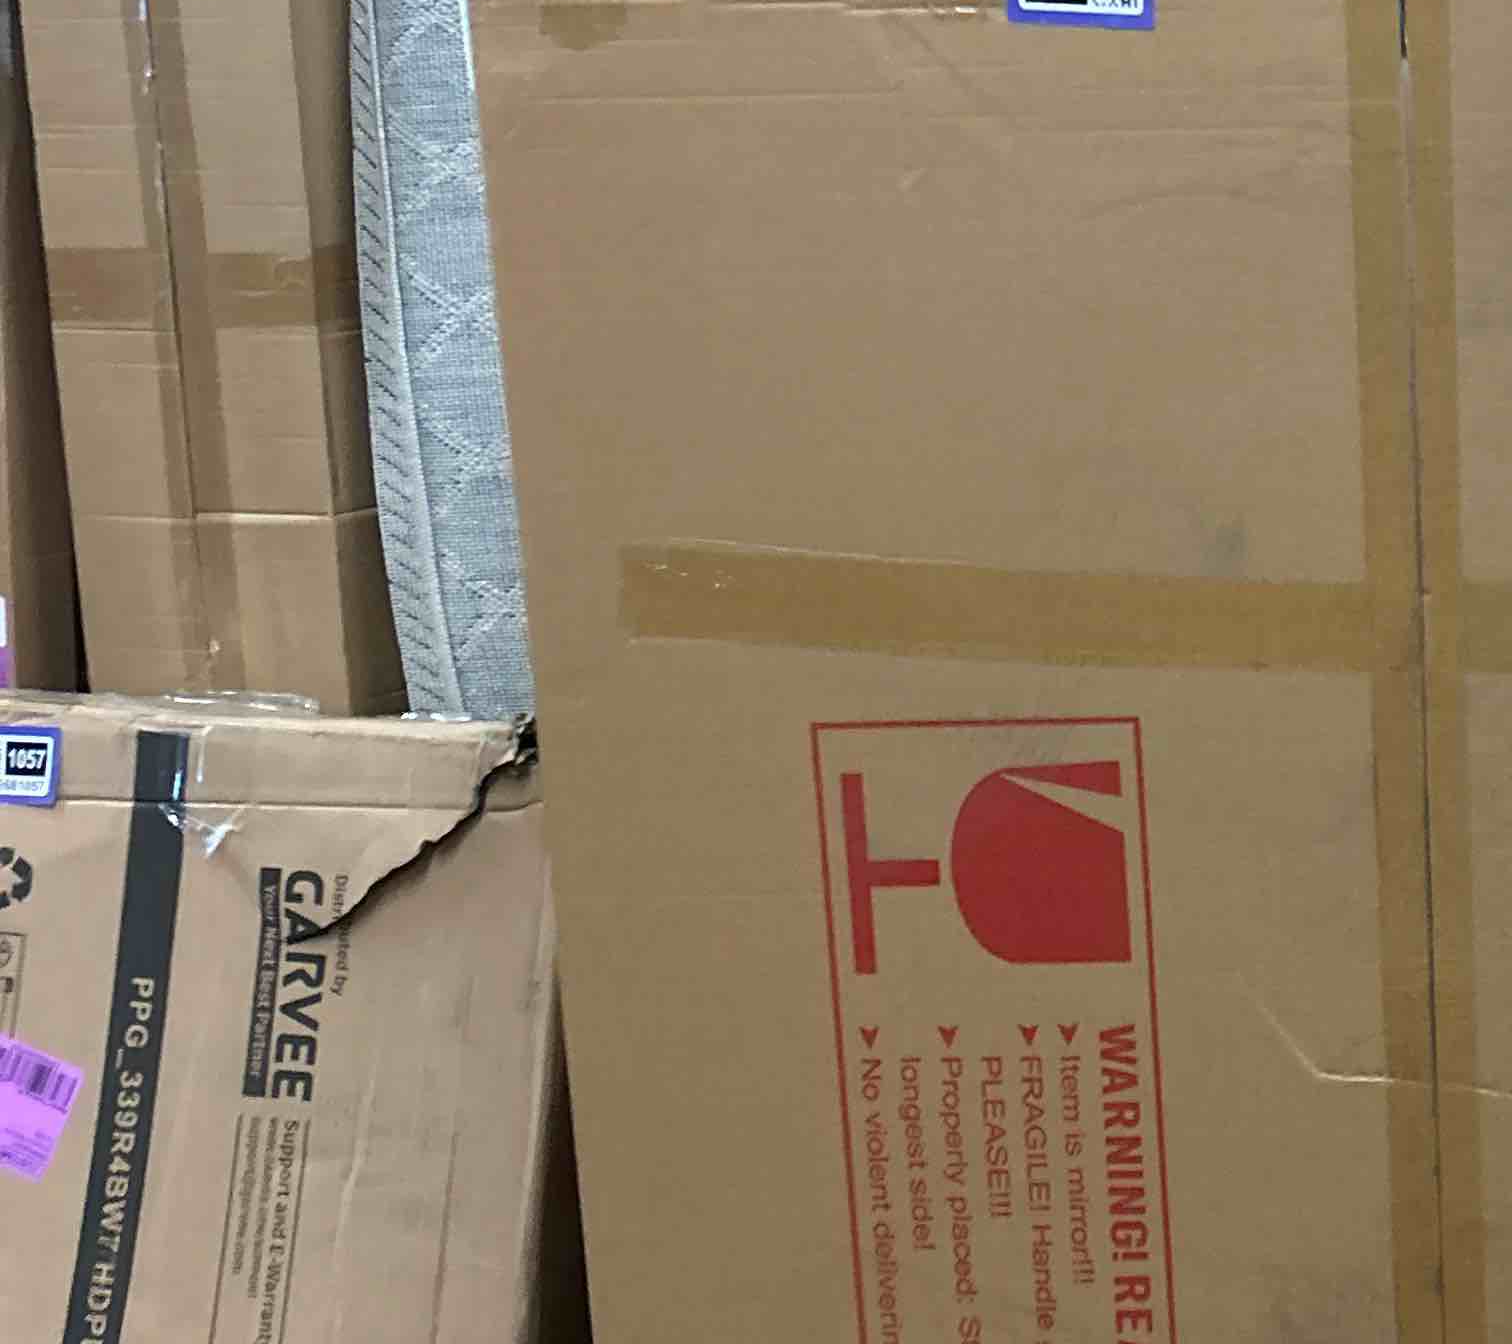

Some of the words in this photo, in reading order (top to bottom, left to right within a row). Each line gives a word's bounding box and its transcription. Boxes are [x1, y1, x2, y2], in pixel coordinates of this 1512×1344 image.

[7, 747, 46, 770] 1057
[262, 883, 277, 923] Your
[259, 927, 279, 967] Next
[256, 971, 274, 1009] Best
[271, 869, 327, 1102] GARVEE
[329, 976, 348, 997] by
[247, 1011, 270, 1080] Partner
[860, 1058, 883, 1102] No
[899, 1055, 927, 1170] longest
[939, 1056, 970, 1187] Properly
[1060, 1055, 1083, 1126] Item
[276, 1119, 300, 1198] Support
[865, 1111, 893, 1214] violent
[1018, 1055, 1050, 1211] FRAGILE!
[1065, 1135, 1083, 1157] is
[1098, 1022, 1152, 1263] WARNING!
[271, 1201, 288, 1241] and
[1029, 1221, 1056, 1330] Handle
